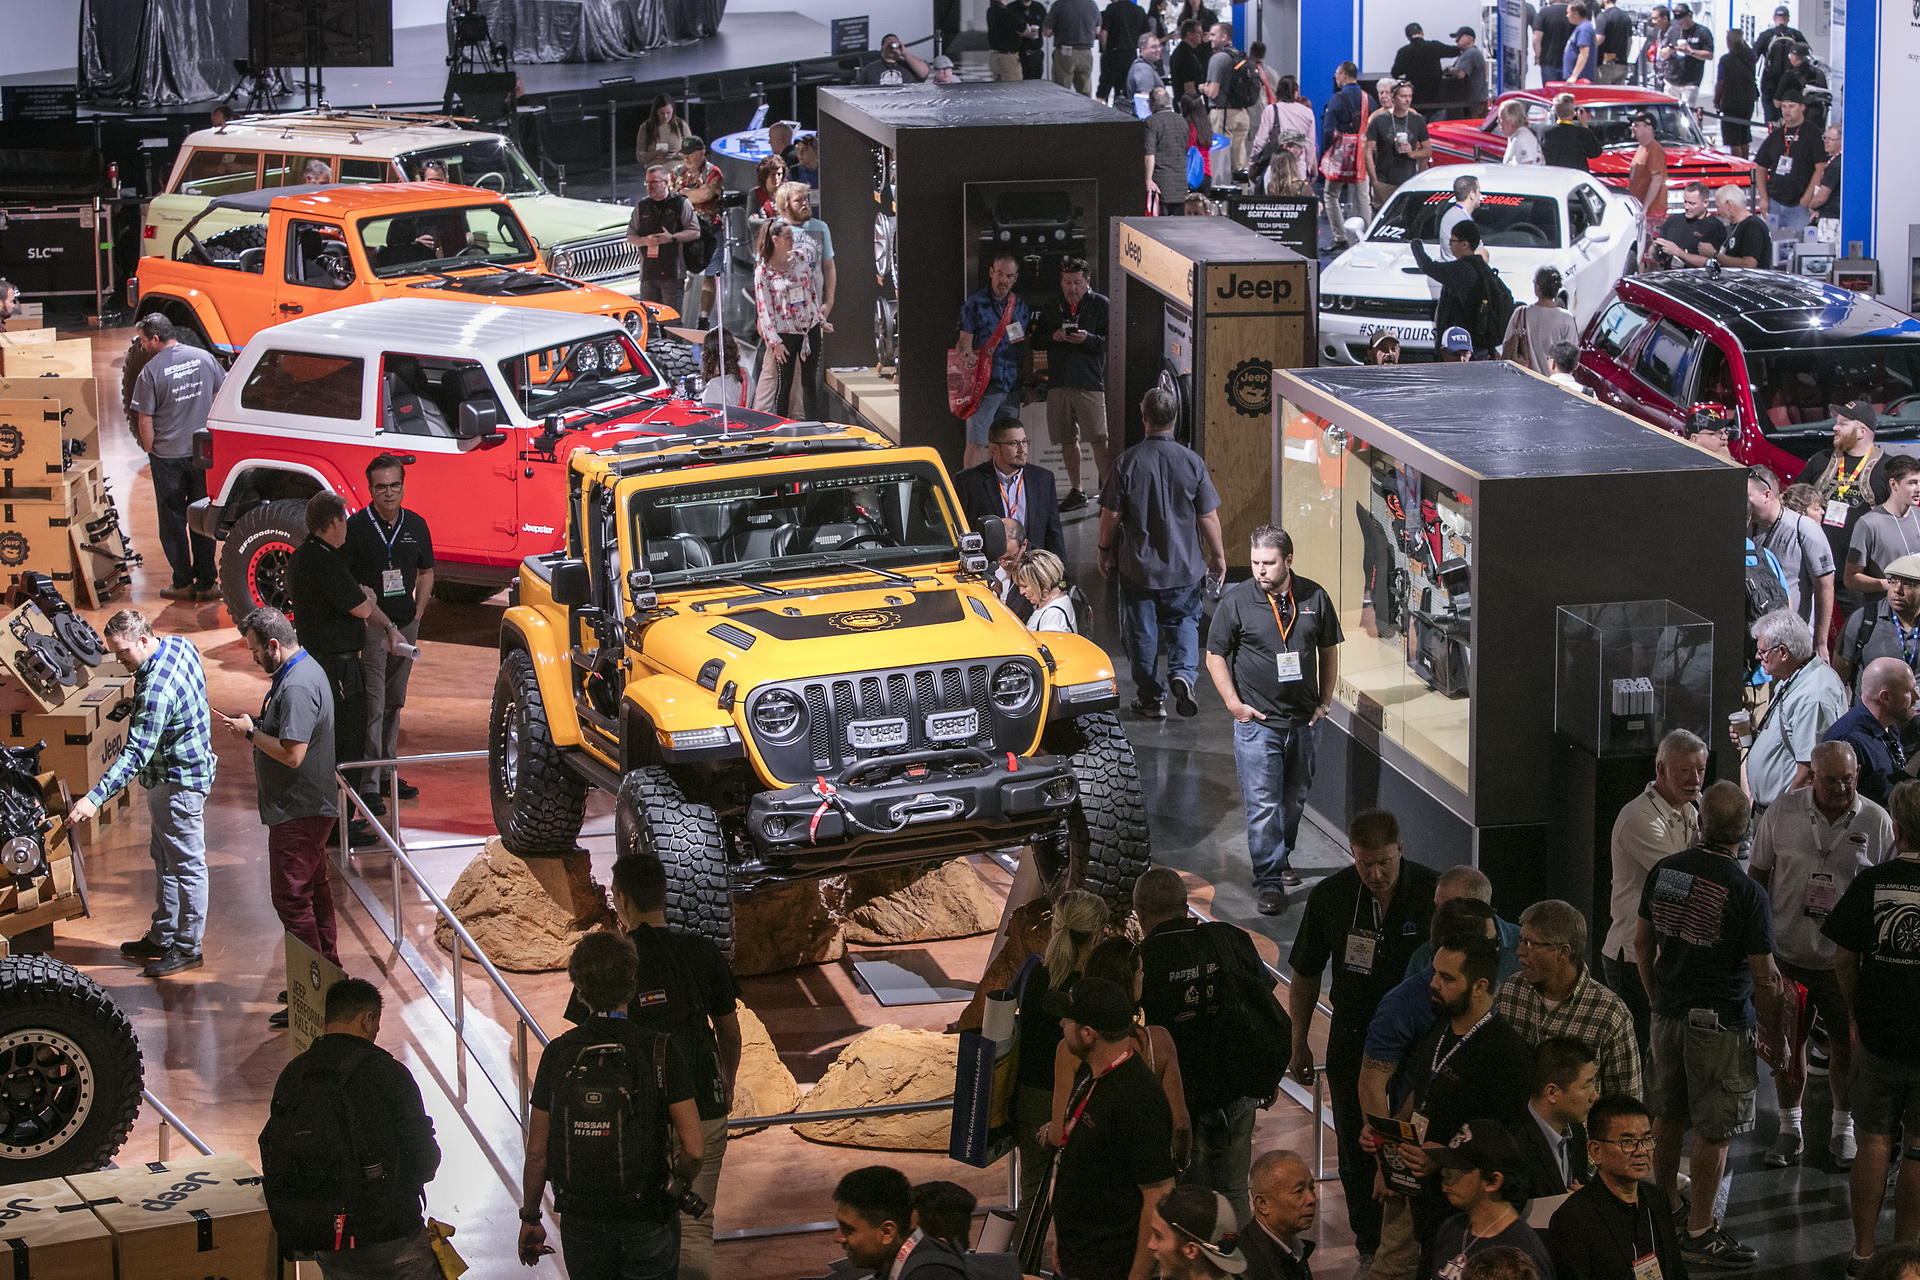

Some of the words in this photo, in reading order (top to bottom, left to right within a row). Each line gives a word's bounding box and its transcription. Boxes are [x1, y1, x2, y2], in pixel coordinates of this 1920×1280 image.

[1907, 54, 1920, 63] SR
[1481, 195, 1525, 206] GARAGE
[1247, 210, 1264, 218] SCAT
[1296, 204, 1308, 212] R/T
[28, 247, 52, 259] SLC
[1124, 232, 1141, 267] Jeep
[1216, 273, 1292, 303] Jeep
[1451, 334, 1467, 342] YETI
[1240, 372, 1267, 383] Jeep
[522, 522, 555, 534] Jeepster
[2, 538, 21, 547] Jeep
[238, 528, 291, 554] BFGoodrich
[101, 733, 122, 764] Jeep
[1875, 954, 1914, 964] DELLENBACH
[293, 979, 306, 1000] JEEP
[294, 1013, 308, 1036] AXLE
[1462, 1026, 1477, 1042] TOYO
[656, 1065, 664, 1088] SONY
[966, 1048, 982, 1158] WWW.ROHANAWHEELS.COM
[574, 1120, 610, 1130] NISSAN
[574, 1128, 610, 1137] nismo
[141, 1172, 221, 1212] Jeep
